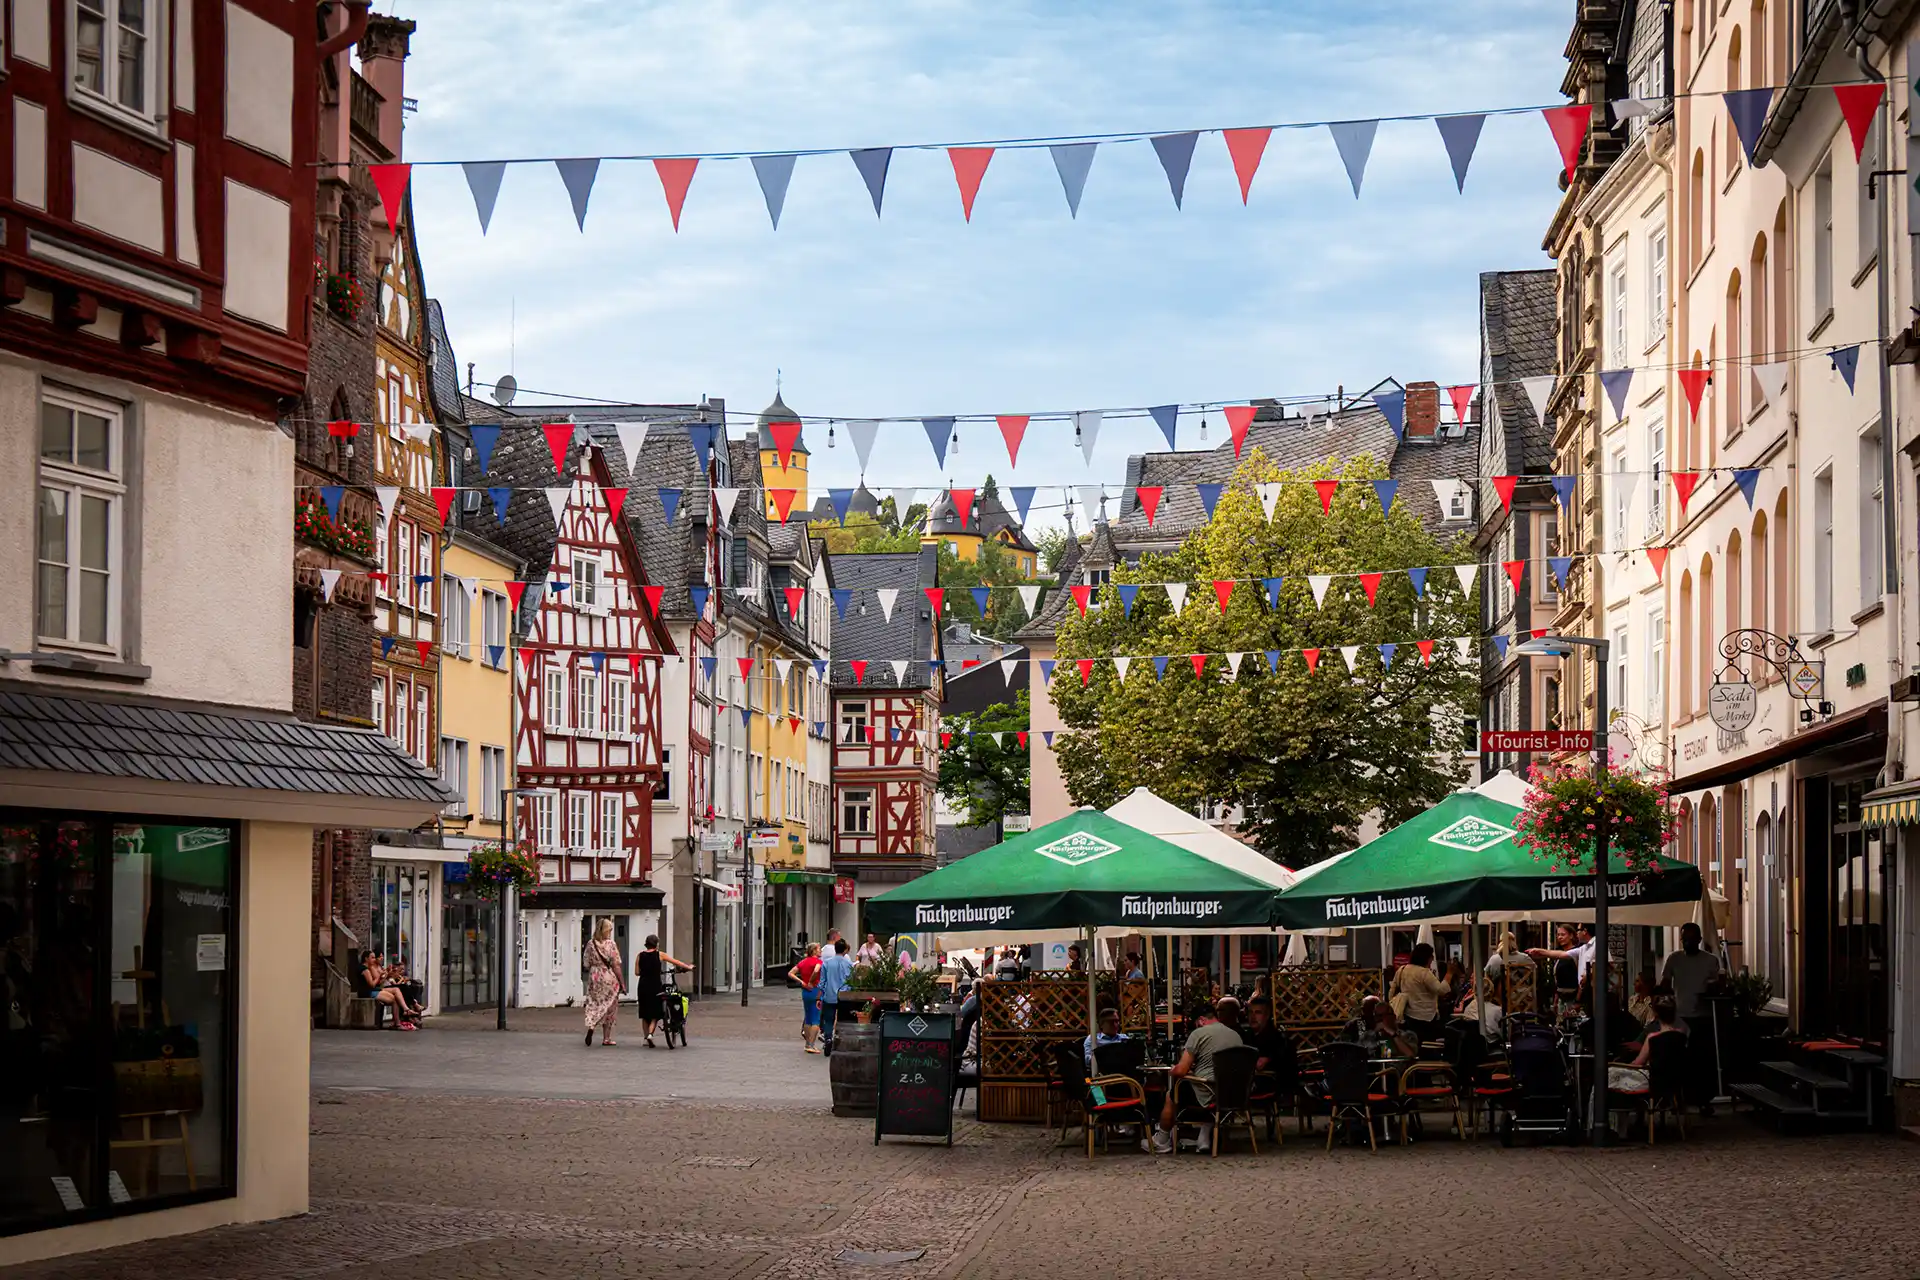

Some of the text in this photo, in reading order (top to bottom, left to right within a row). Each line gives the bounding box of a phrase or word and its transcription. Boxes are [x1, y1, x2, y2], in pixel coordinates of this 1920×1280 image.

[1711, 687, 1753, 703] Scala
[1725, 702, 1741, 710] am
[1715, 711, 1752, 723] Markt
[1494, 733, 1590, 749] Tourist-Info
[915, 903, 1012, 929] Hachenburger
[1121, 895, 1221, 921] Hachenburger
[1325, 895, 1428, 921] Hachenburger
